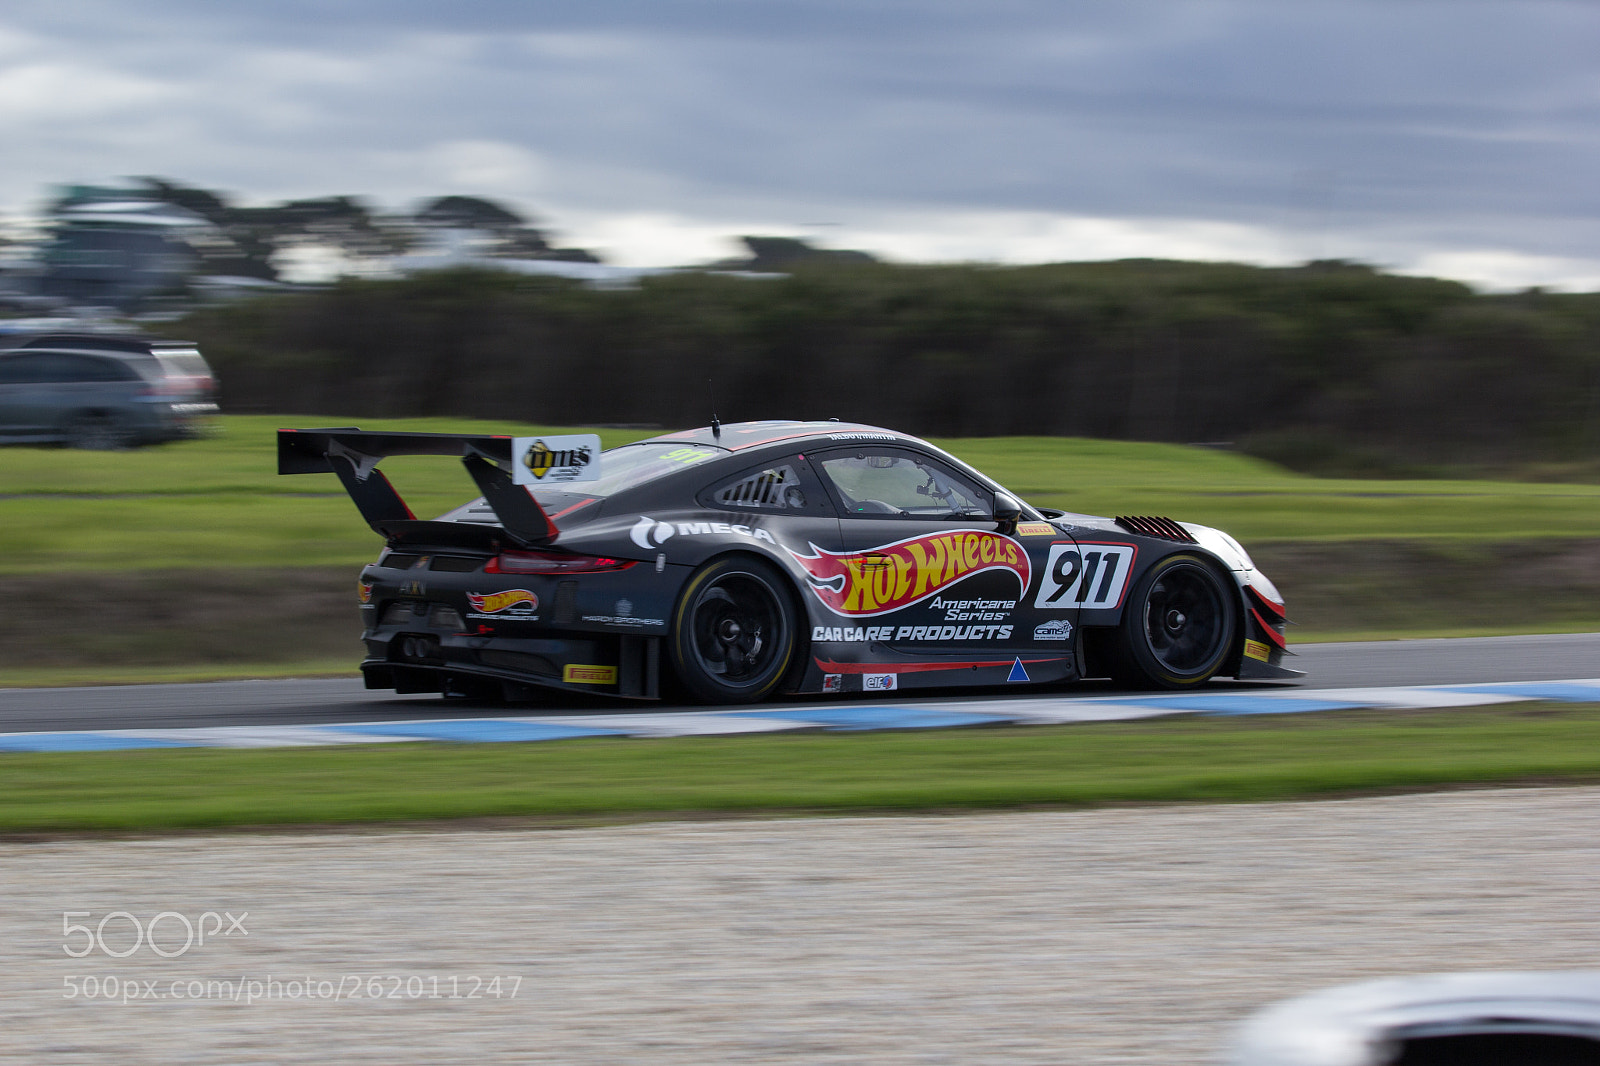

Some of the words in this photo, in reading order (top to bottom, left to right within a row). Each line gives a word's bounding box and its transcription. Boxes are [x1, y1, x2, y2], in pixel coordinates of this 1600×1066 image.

[659, 448, 714, 464] 911
[1018, 525, 1052, 534] PIRELLI
[1045, 550, 1121, 603] 911
[929, 596, 1016, 609] Americana
[895, 625, 1014, 641] PRODUCTS
[867, 676, 884, 689] elf
